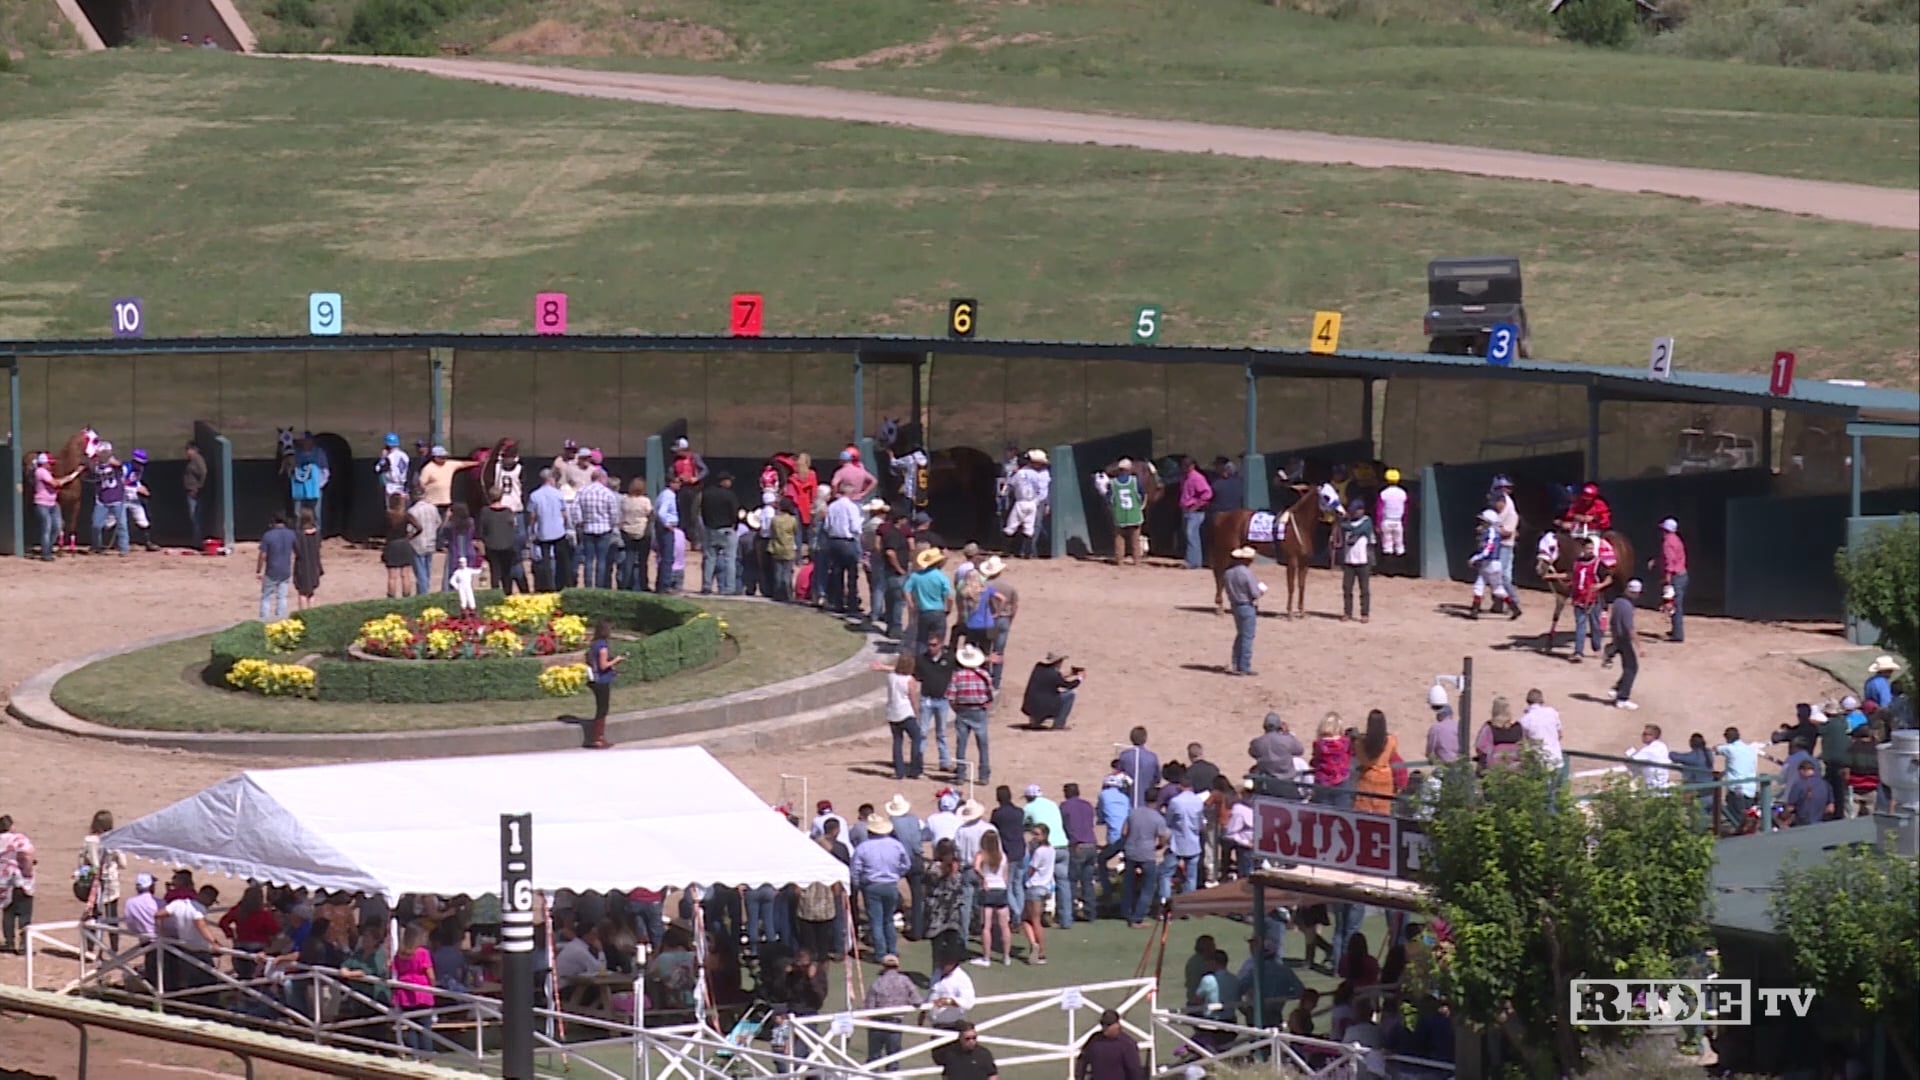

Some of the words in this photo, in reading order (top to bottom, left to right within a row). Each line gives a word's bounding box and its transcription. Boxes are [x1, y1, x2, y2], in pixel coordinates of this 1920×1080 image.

[115, 302, 139, 332] 10
[317, 301, 334, 328] 9
[543, 300, 560, 326] 8
[737, 301, 756, 328] 7
[953, 303, 972, 333] 6
[1136, 309, 1156, 338] 5
[1317, 319, 1332, 345] 4
[1492, 328, 1511, 359] 3
[1653, 344, 1666, 372] 2
[1777, 358, 1787, 388] 1
[502, 475, 513, 494] 8
[1118, 489, 1133, 509] 5
[1579, 567, 1588, 590] 1
[508, 822, 523, 854] 1
[1258, 804, 1392, 871] RIDE
